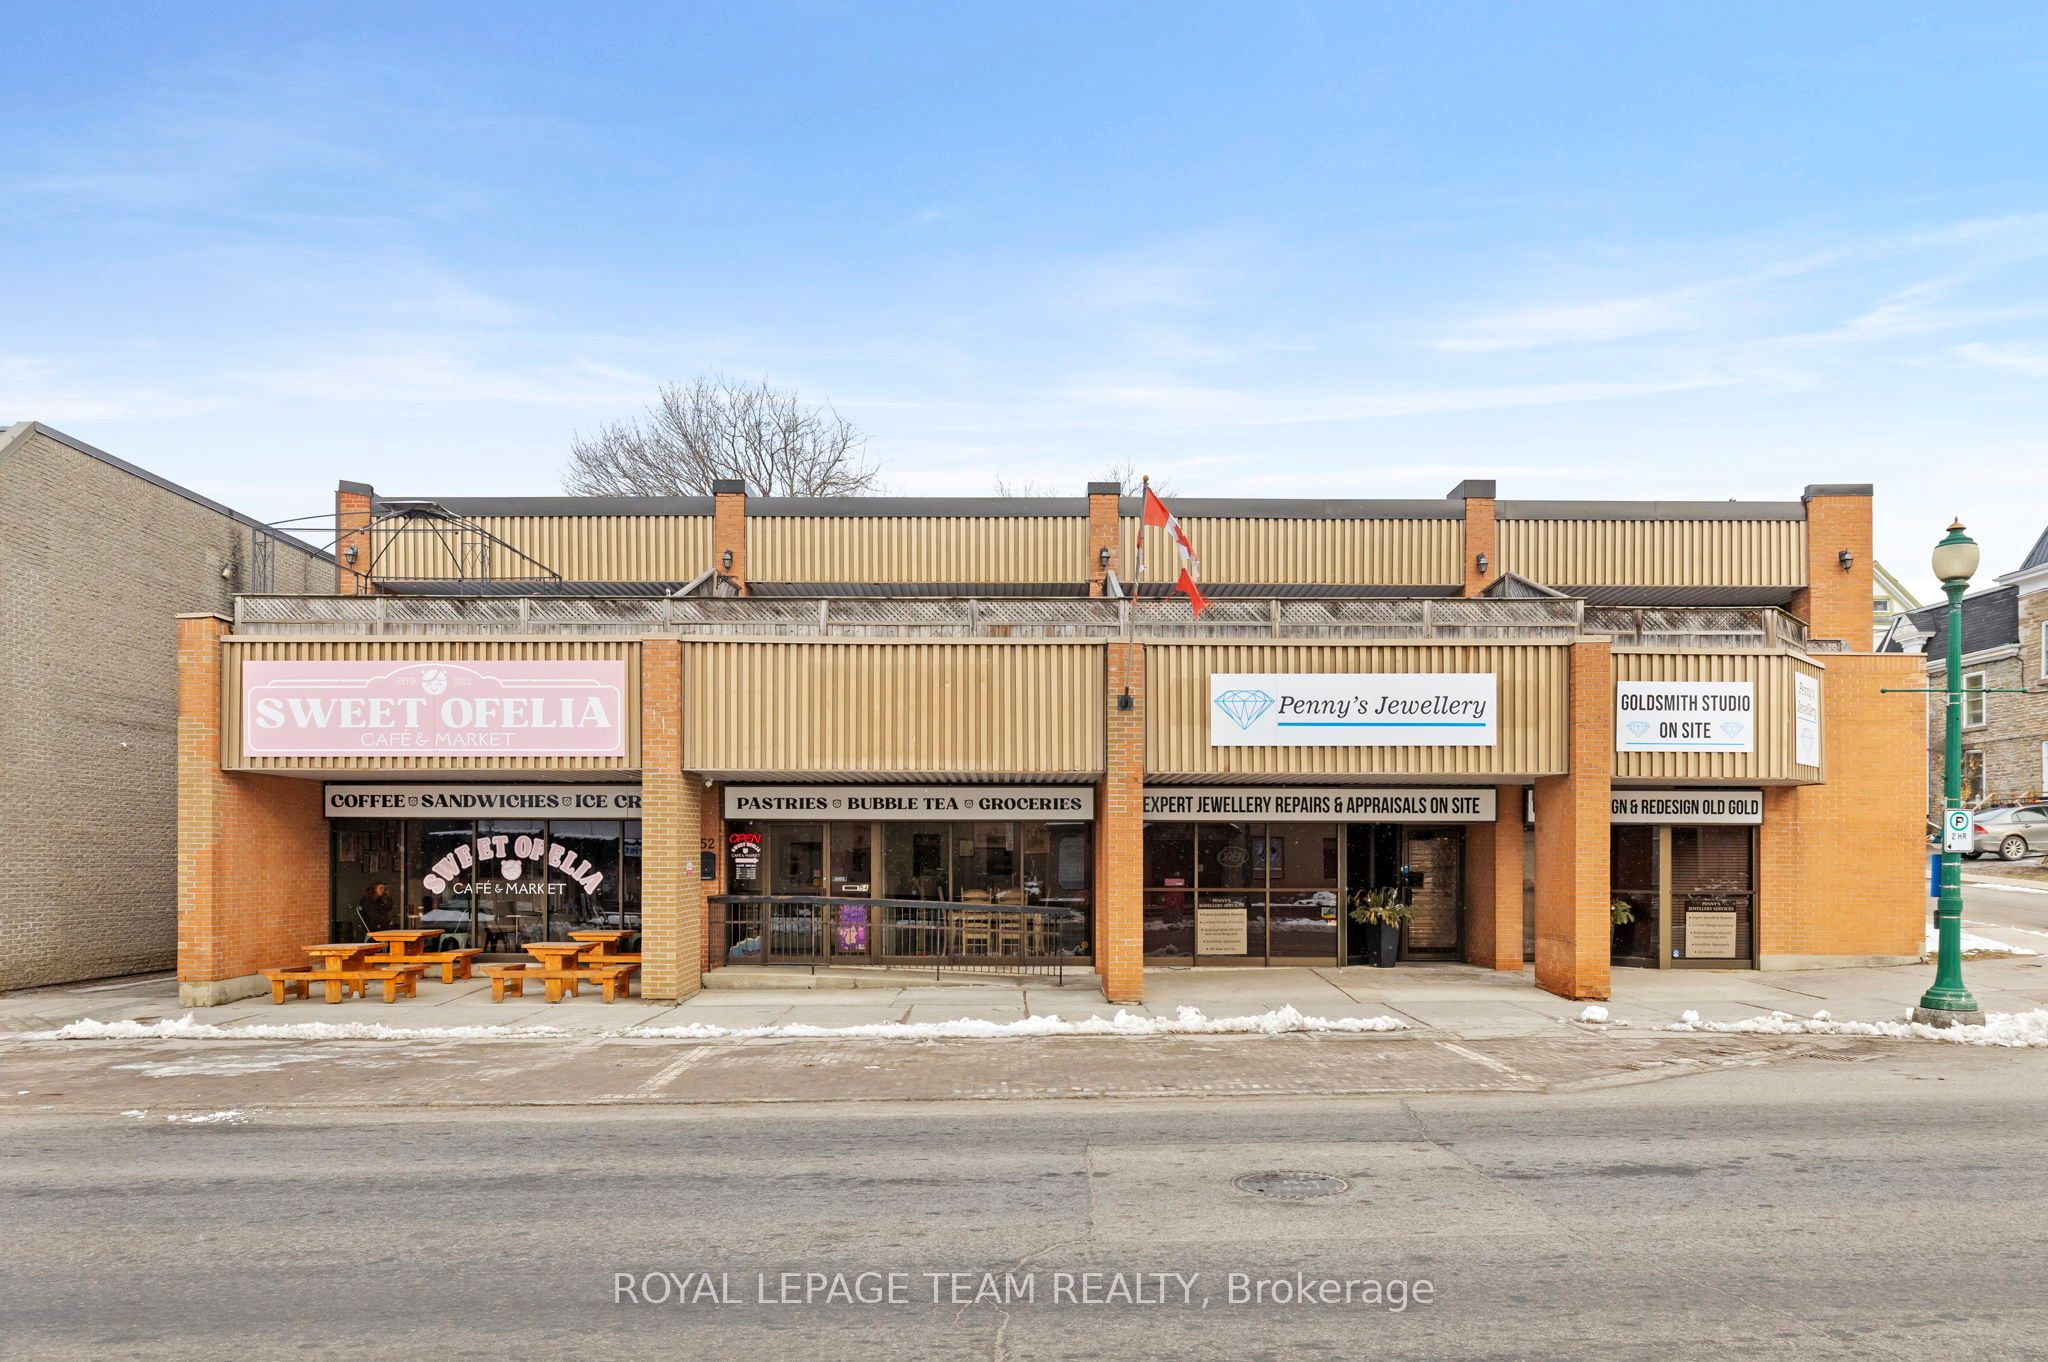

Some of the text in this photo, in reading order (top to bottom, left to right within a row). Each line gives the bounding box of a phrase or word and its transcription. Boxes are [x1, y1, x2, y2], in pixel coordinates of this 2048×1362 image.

[1278, 695, 1486, 719] Penny's Jewellery
[1621, 694, 1750, 712] GOLDSMITH STUDIO
[256, 697, 611, 728] SWEET OFELIA
[361, 729, 515, 746] CAFÉ & MARKET
[1659, 722, 1711, 738] ON SITE
[331, 794, 642, 808] COFFEE SANDWICHES ICE CR
[737, 797, 1082, 811] PASTRIES BUBBLE TEA GROCERIES
[1143, 796, 1480, 814] EXPERT JEWELLERY REPAIRS & APPRAISALS ON SITE
[1612, 799, 1758, 814] GN & REDESIGN OLD GOLD
[1955, 816, 1964, 826] P
[729, 833, 762, 843] OPEN
[1951, 832, 1967, 840] 2 HR
[423, 835, 603, 895] SWEET OFELIA
[453, 880, 567, 895] CAFÉ & MARKET
